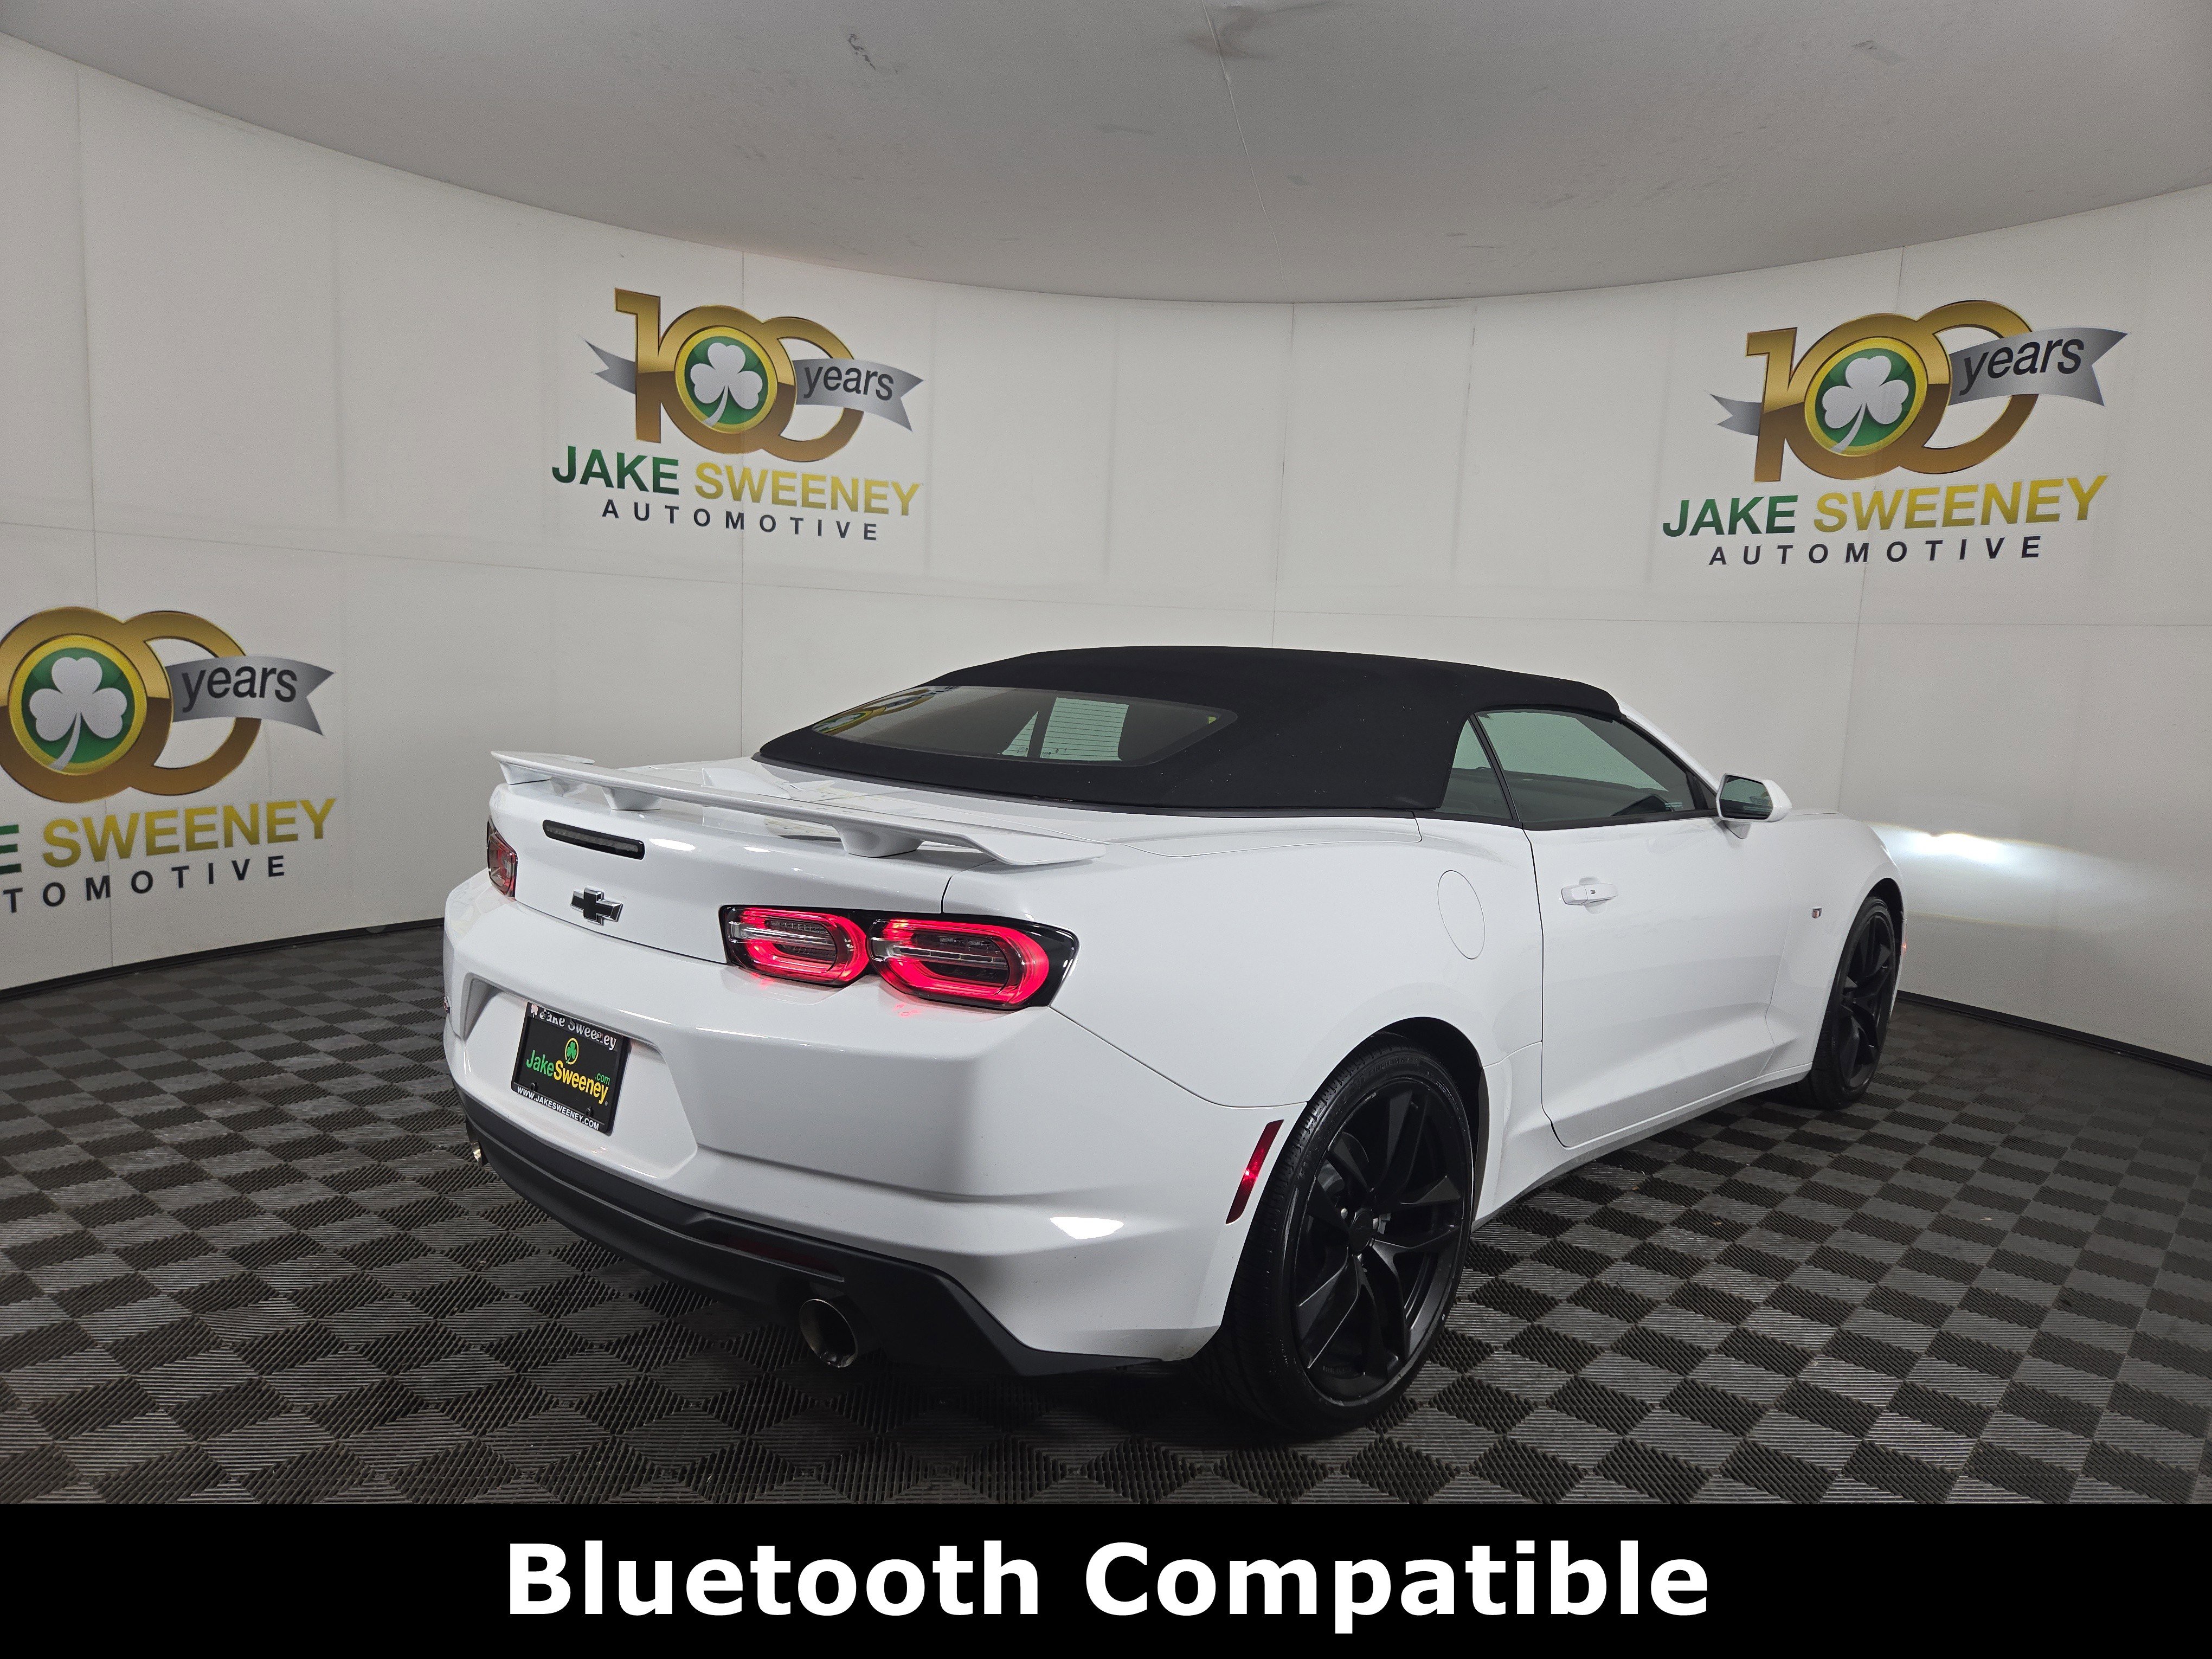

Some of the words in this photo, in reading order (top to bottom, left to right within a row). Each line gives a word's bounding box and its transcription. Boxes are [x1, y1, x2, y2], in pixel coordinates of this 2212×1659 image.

[803, 365, 894, 401] years
[1959, 338, 2085, 396] years
[552, 445, 679, 495] JAKE
[695, 462, 921, 516] SWEENEY
[602, 499, 877, 541] AUTOMOTIVE
[1663, 494, 1799, 537] JAKE
[1814, 475, 2108, 533] SWEENEY
[1709, 536, 2042, 565] AUTOMOTIVE
[181, 665, 297, 712] years
[42, 798, 336, 867] SWEENEY
[517, 1086, 600, 1130] WWW.JAKESWEENEY.COM
